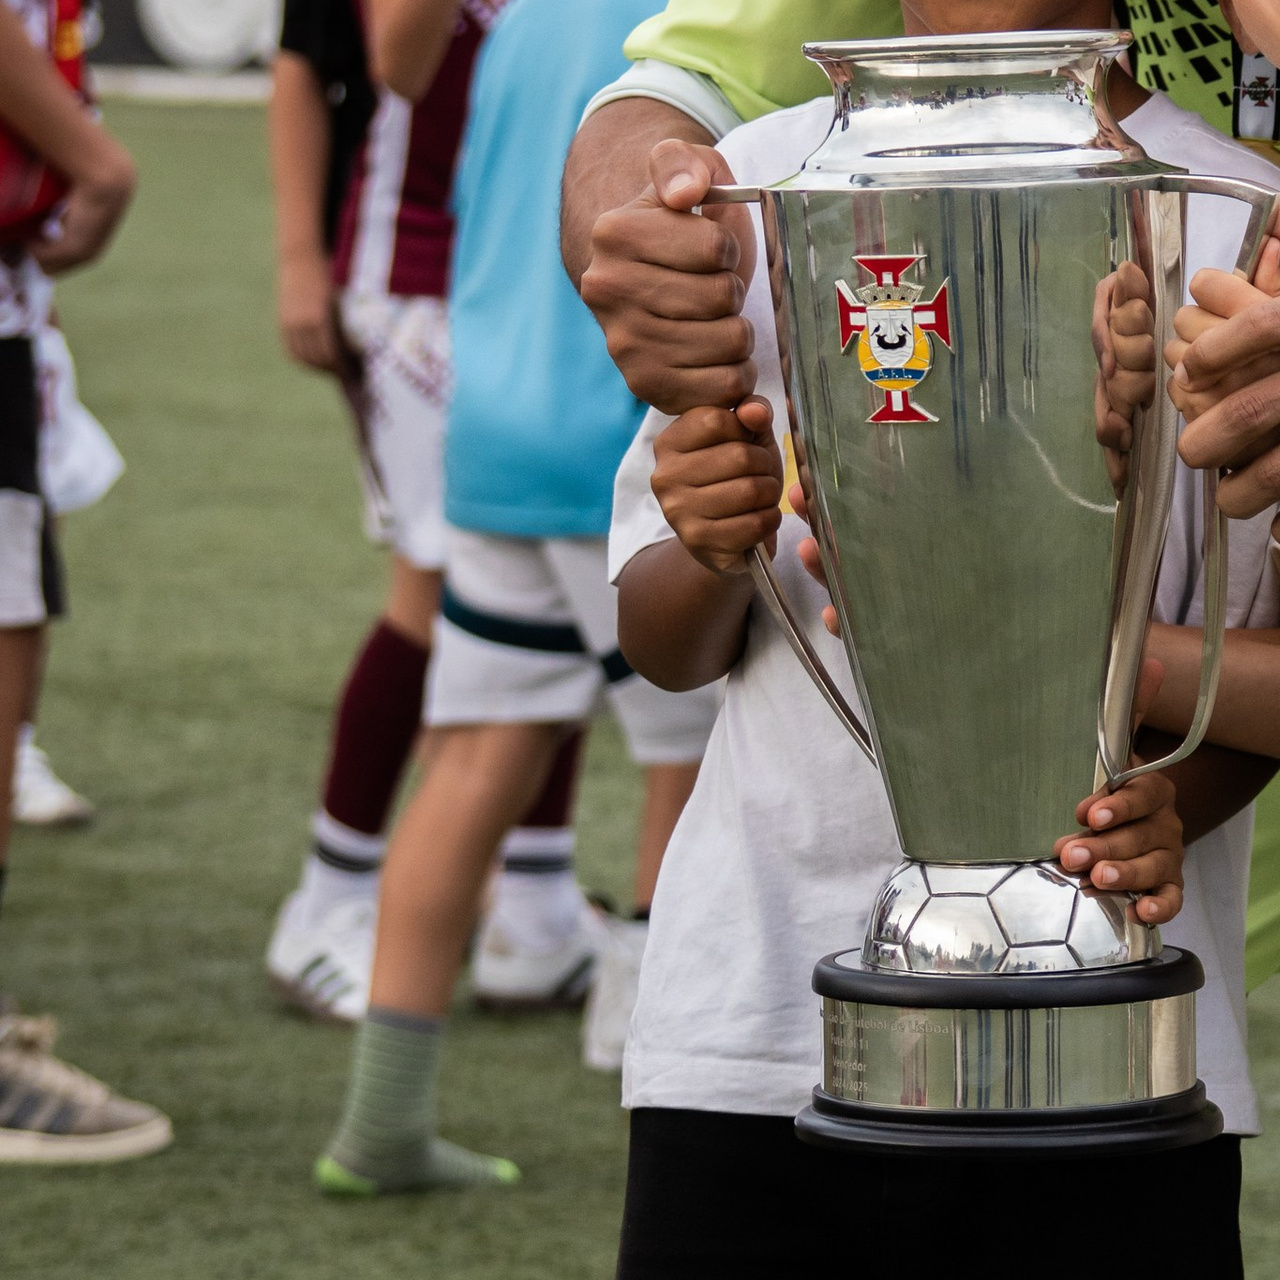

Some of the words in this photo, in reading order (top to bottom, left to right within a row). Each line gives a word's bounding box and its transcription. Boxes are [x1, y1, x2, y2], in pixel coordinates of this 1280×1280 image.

[877, 368, 913, 379] A.F.L.
[908, 1019, 950, 1034] Lisboa
[832, 1054, 867, 1072] Vencedor
